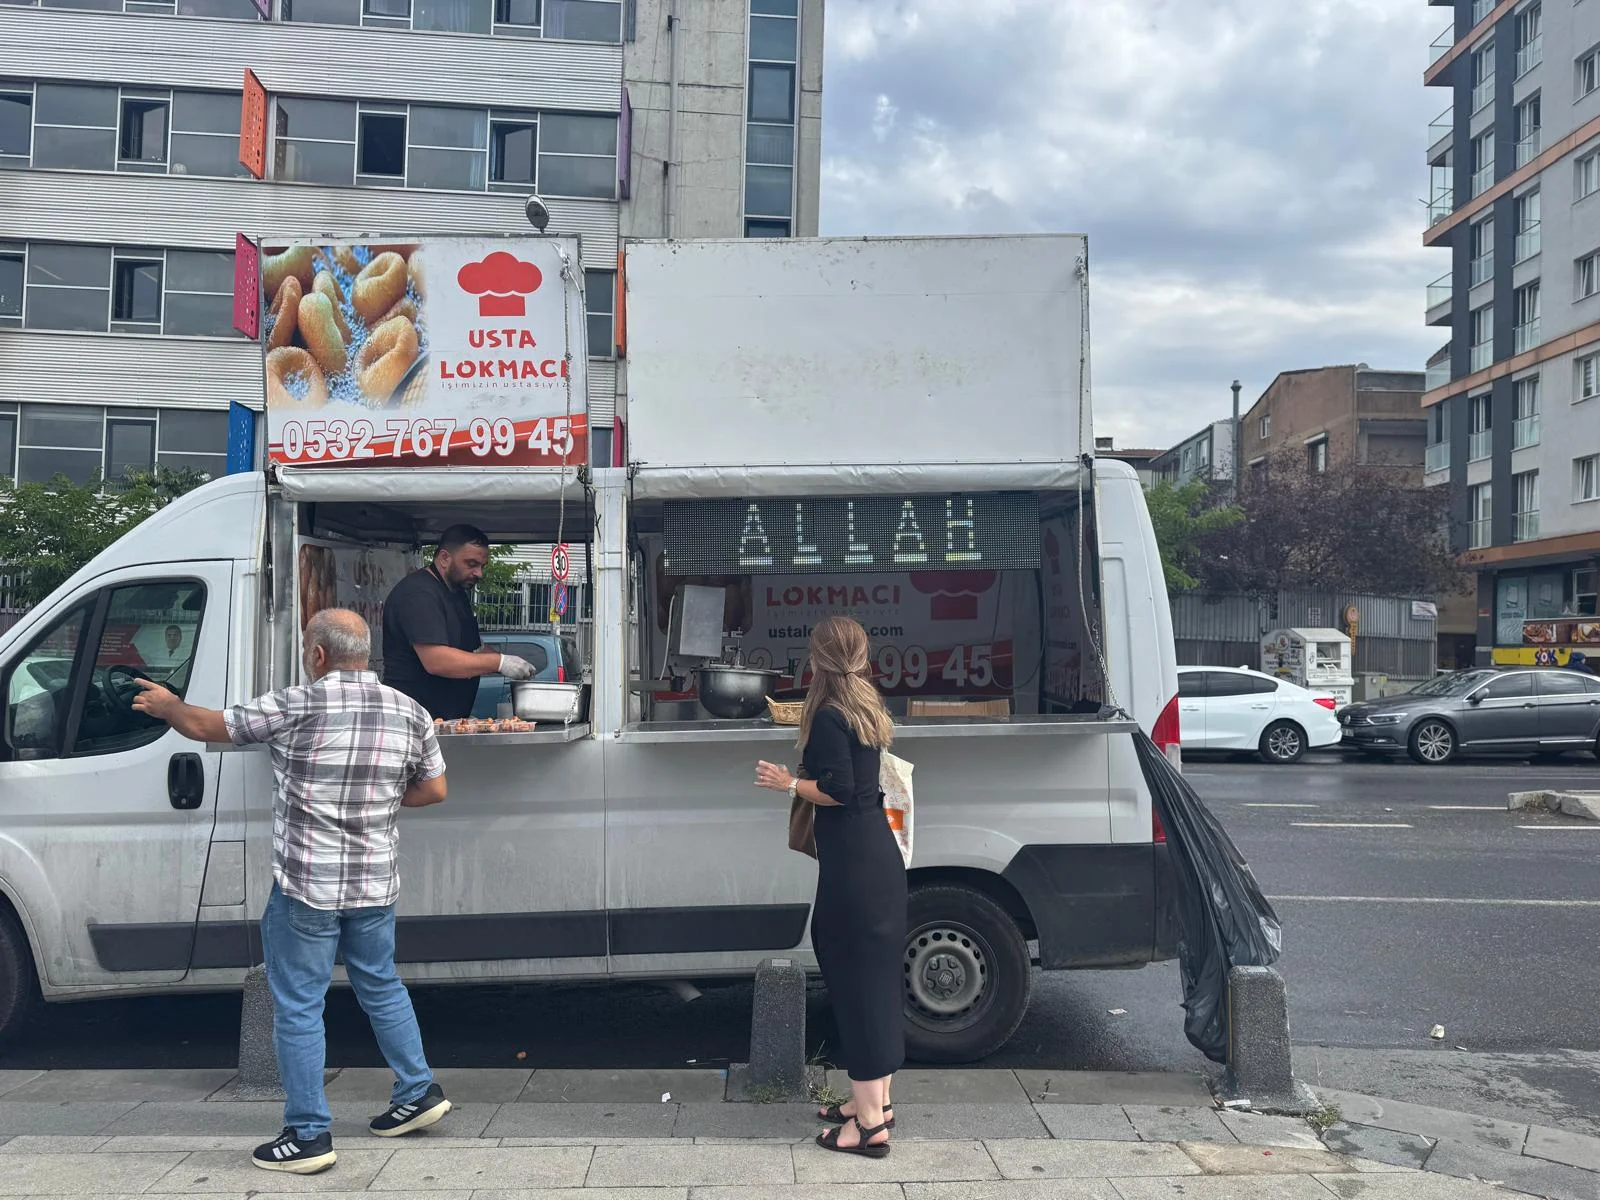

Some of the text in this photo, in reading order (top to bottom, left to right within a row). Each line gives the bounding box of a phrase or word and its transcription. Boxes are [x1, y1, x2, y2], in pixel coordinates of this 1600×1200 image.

[468, 328, 537, 349] USTA
[440, 359, 569, 380] LOKMACI
[282, 416, 574, 460] 0532 767 99 45
[738, 499, 982, 566] ALLAH
[555, 555, 566, 571] 30
[765, 584, 901, 607] LOKMACI
[878, 645, 928, 690] 99
[941, 644, 993, 688] 45
